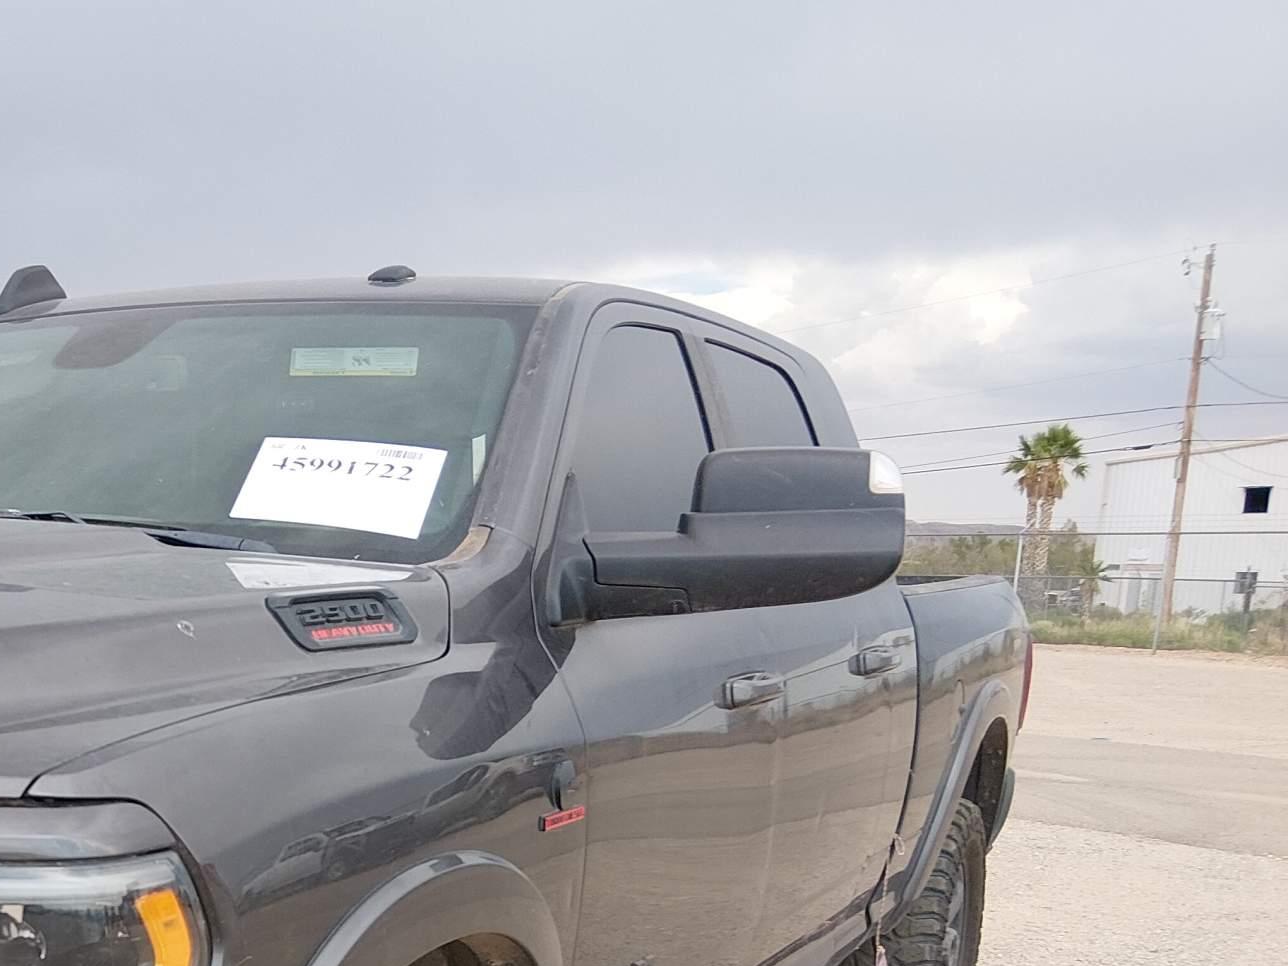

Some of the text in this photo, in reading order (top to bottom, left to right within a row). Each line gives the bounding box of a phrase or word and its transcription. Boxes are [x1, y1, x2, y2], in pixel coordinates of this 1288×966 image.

[272, 456, 414, 481] 45991722
[296, 602, 385, 626] 2500
[312, 621, 395, 641] HEAVY DUTY
